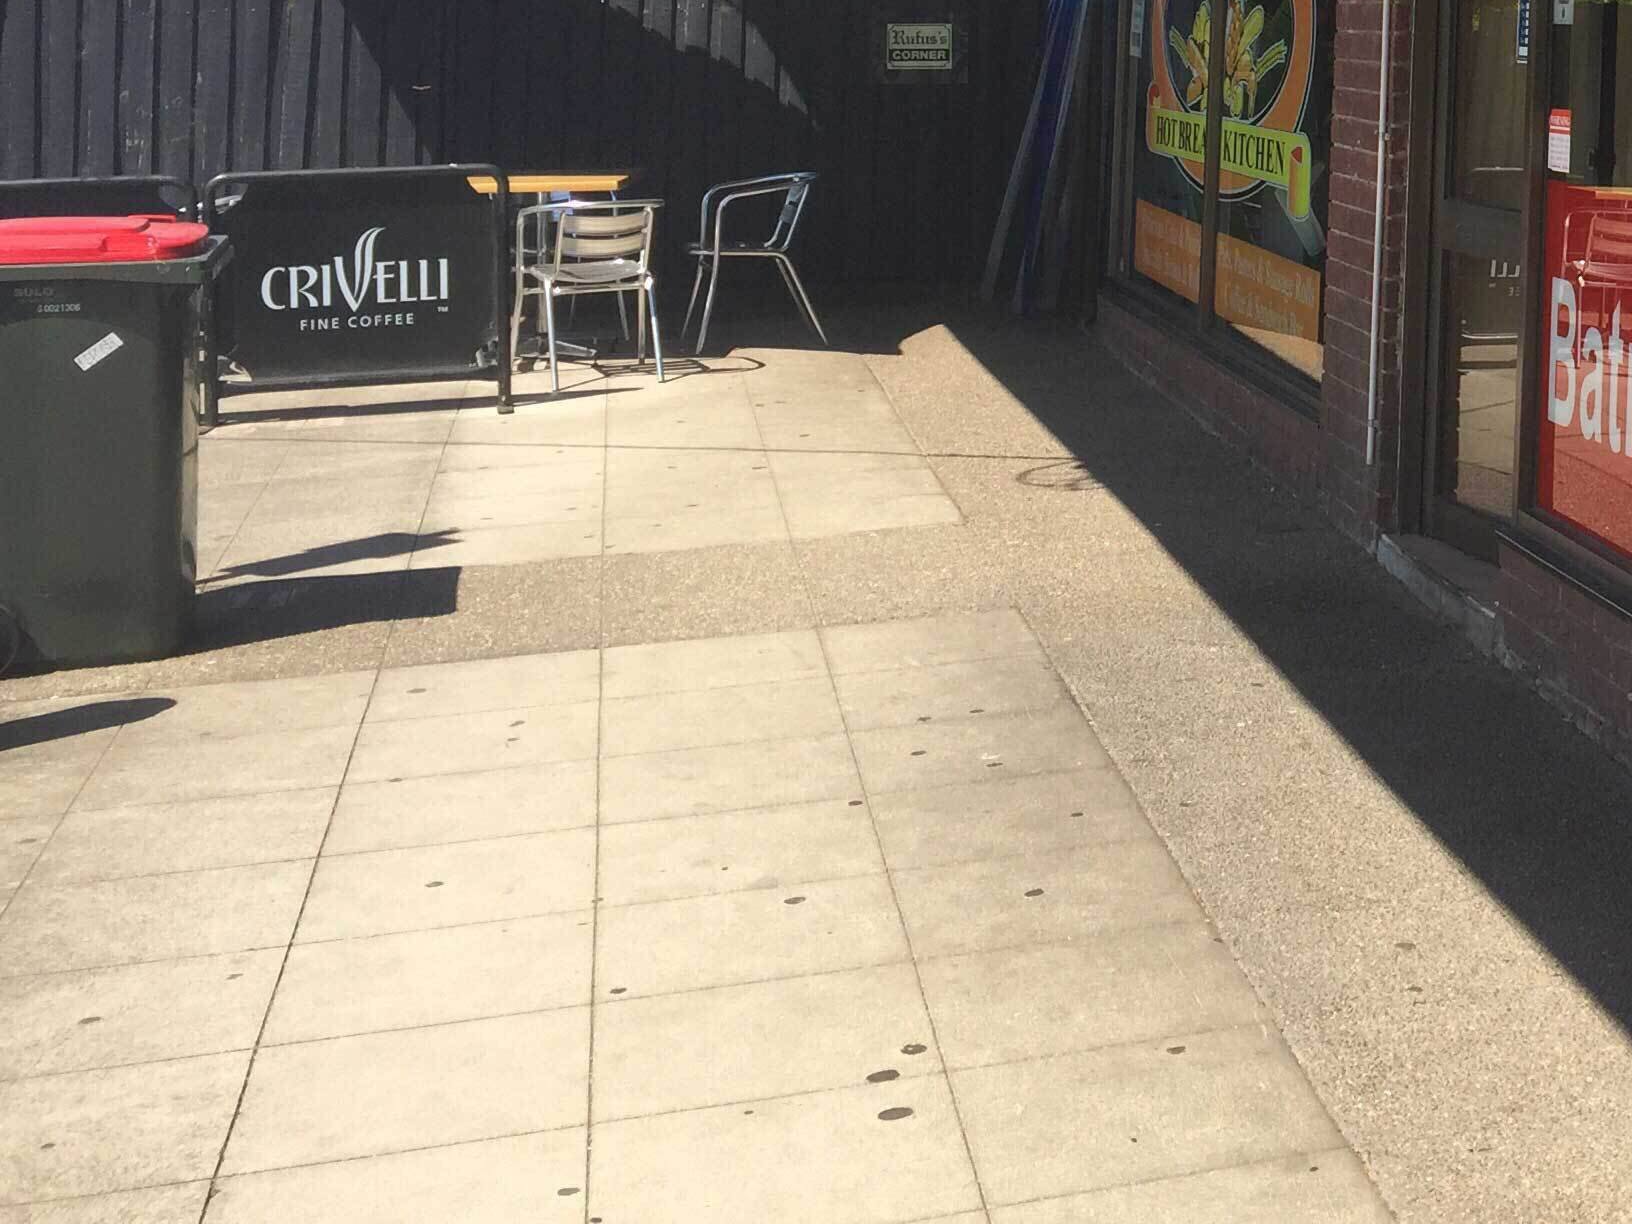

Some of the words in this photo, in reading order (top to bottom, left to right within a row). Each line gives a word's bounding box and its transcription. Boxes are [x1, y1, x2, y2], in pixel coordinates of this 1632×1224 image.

[892, 50, 947, 60] CORNER
[1156, 115, 1178, 147] HOT
[1223, 129, 1286, 177] KITCHEN
[261, 227, 449, 312] CRIVELLI
[300, 317, 341, 331] FINE
[347, 313, 415, 329] COFFEE
